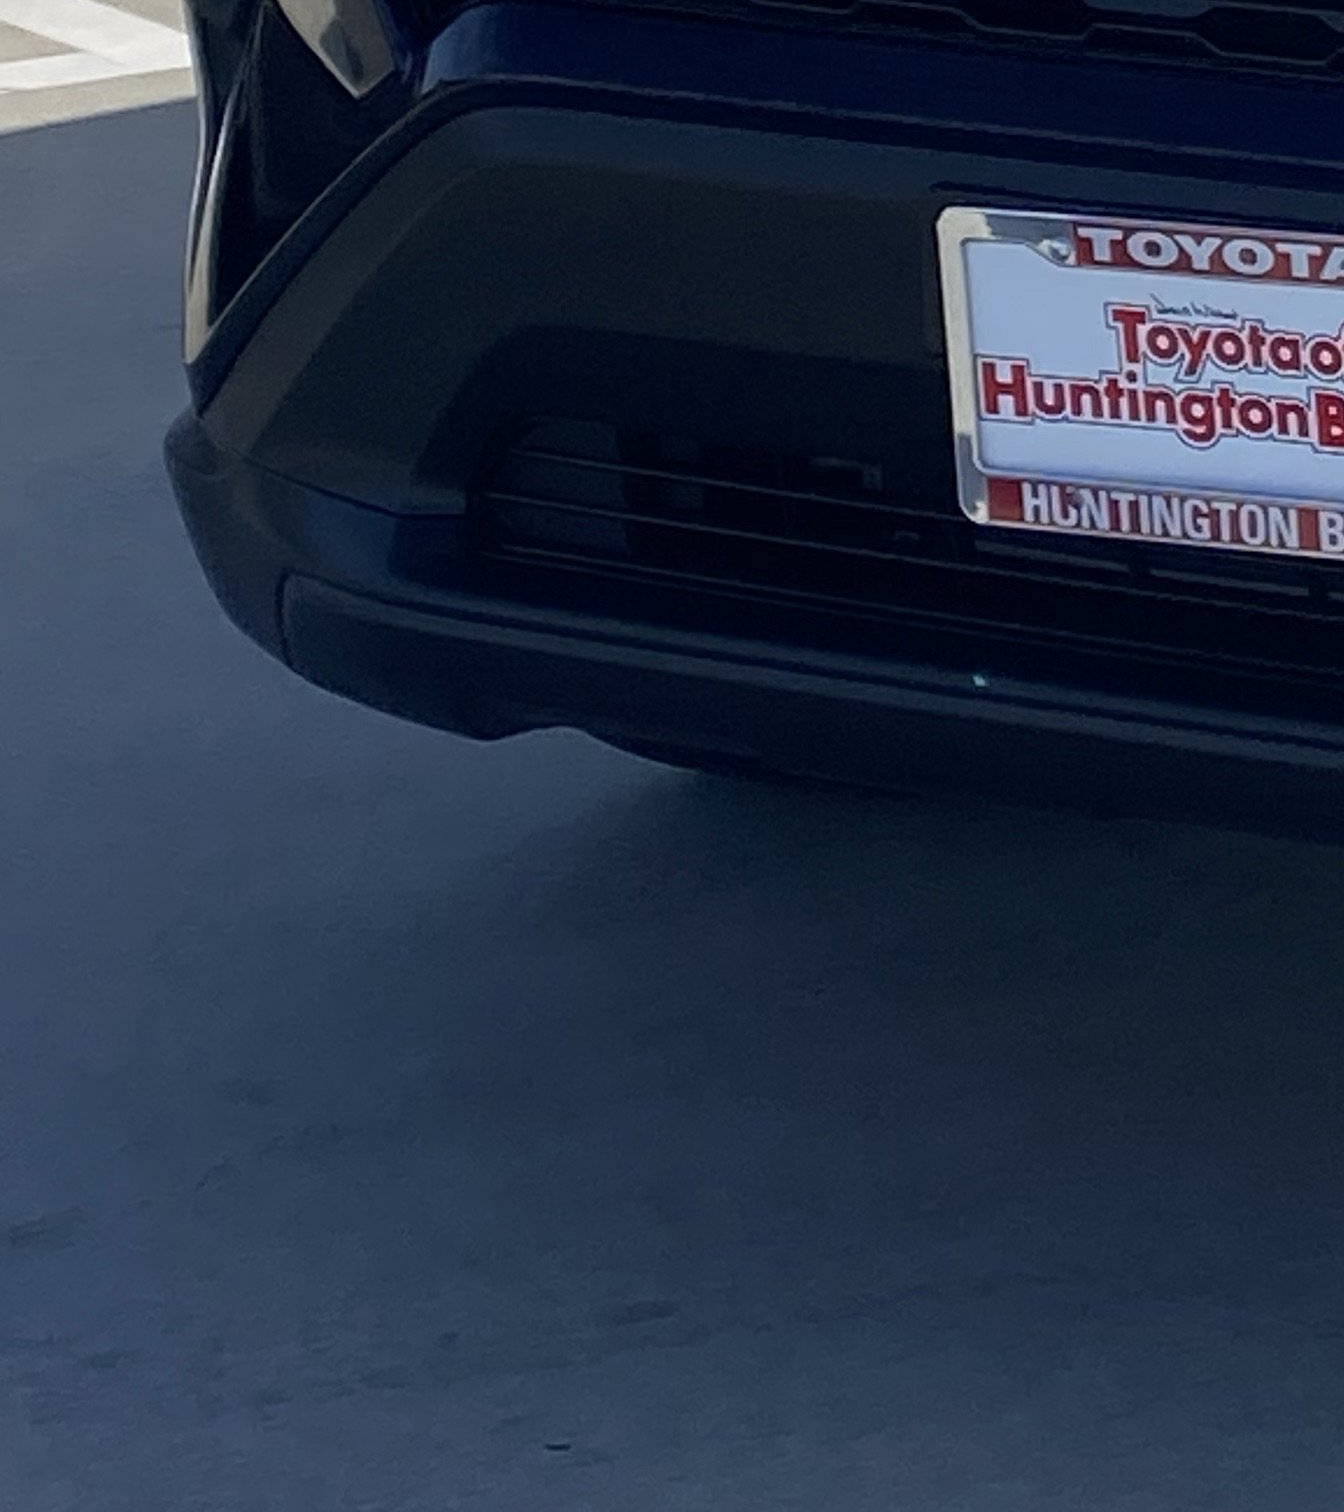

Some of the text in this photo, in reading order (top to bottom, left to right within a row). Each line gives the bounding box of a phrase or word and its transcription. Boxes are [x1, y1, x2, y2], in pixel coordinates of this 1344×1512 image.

[1110, 308, 1305, 377] Toyota
[979, 360, 1310, 445] Huntington
[1021, 482, 1299, 549] HUNTINGTON
